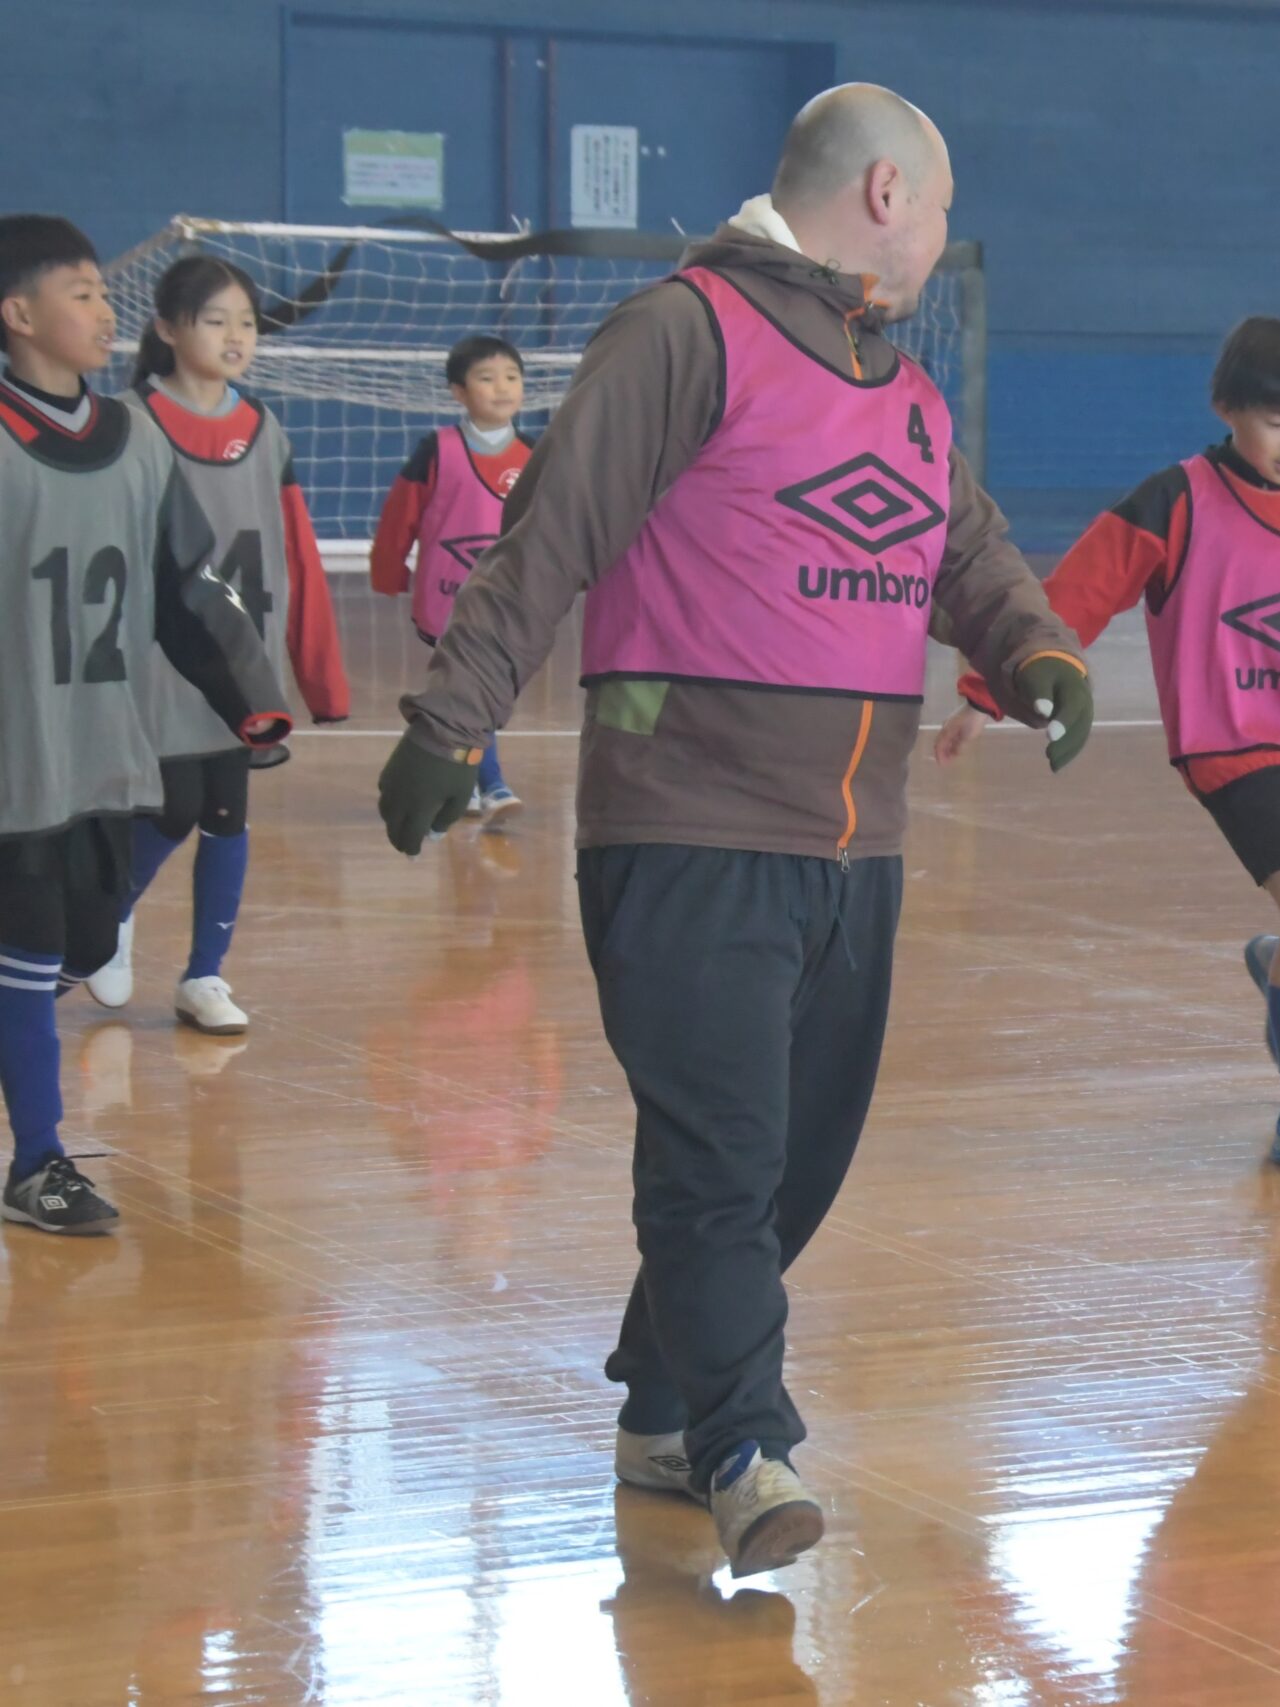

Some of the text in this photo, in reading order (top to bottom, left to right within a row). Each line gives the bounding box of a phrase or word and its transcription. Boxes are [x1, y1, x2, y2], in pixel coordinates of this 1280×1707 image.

[907, 403, 935, 464] 4
[31, 545, 127, 685] 12
[798, 561, 929, 609] umbro
